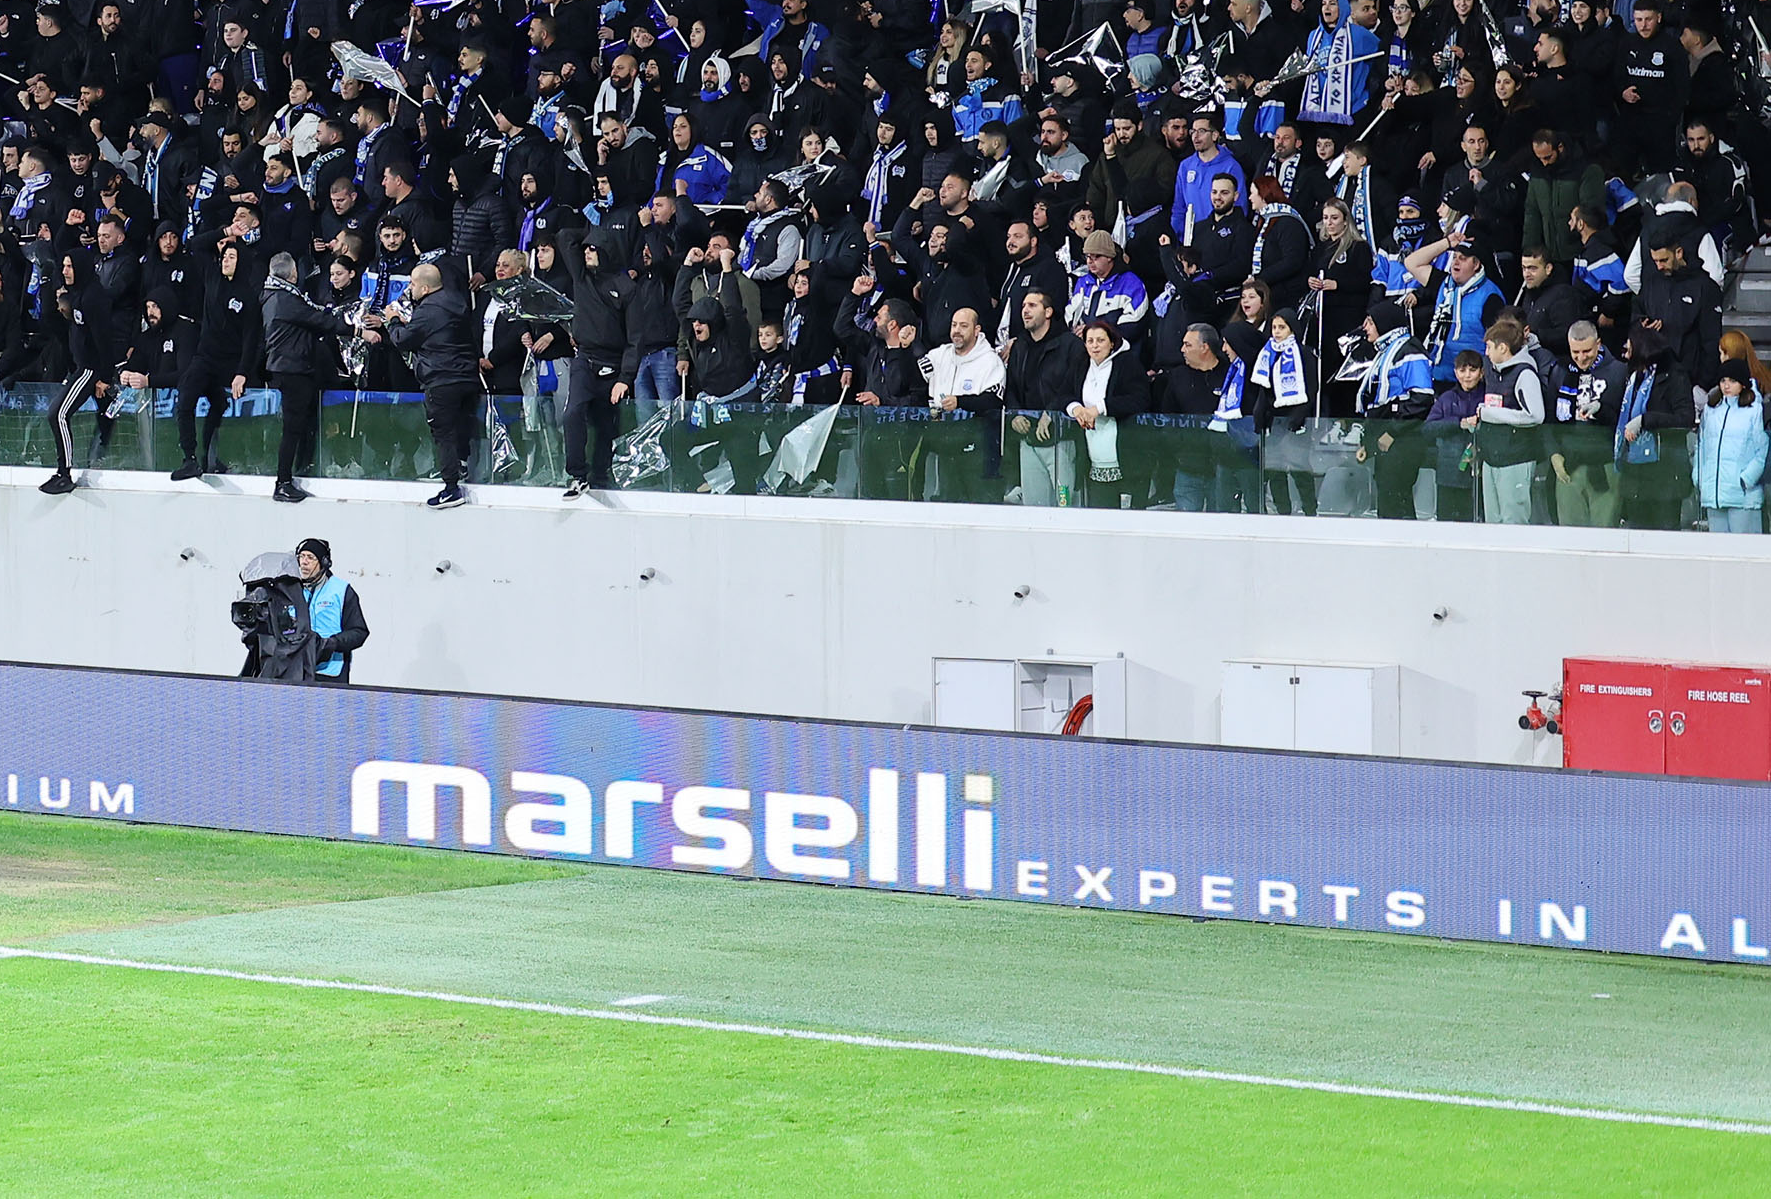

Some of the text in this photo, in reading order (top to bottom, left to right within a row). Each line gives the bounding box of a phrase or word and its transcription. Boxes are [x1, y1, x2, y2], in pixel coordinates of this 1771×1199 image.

[1579, 683, 1653, 696] FIRE EXTINGUISHERS
[1687, 689, 1751, 704] FIRE HOSE REEL
[350, 760, 1769, 957] marselli EXPERTS IN AL
